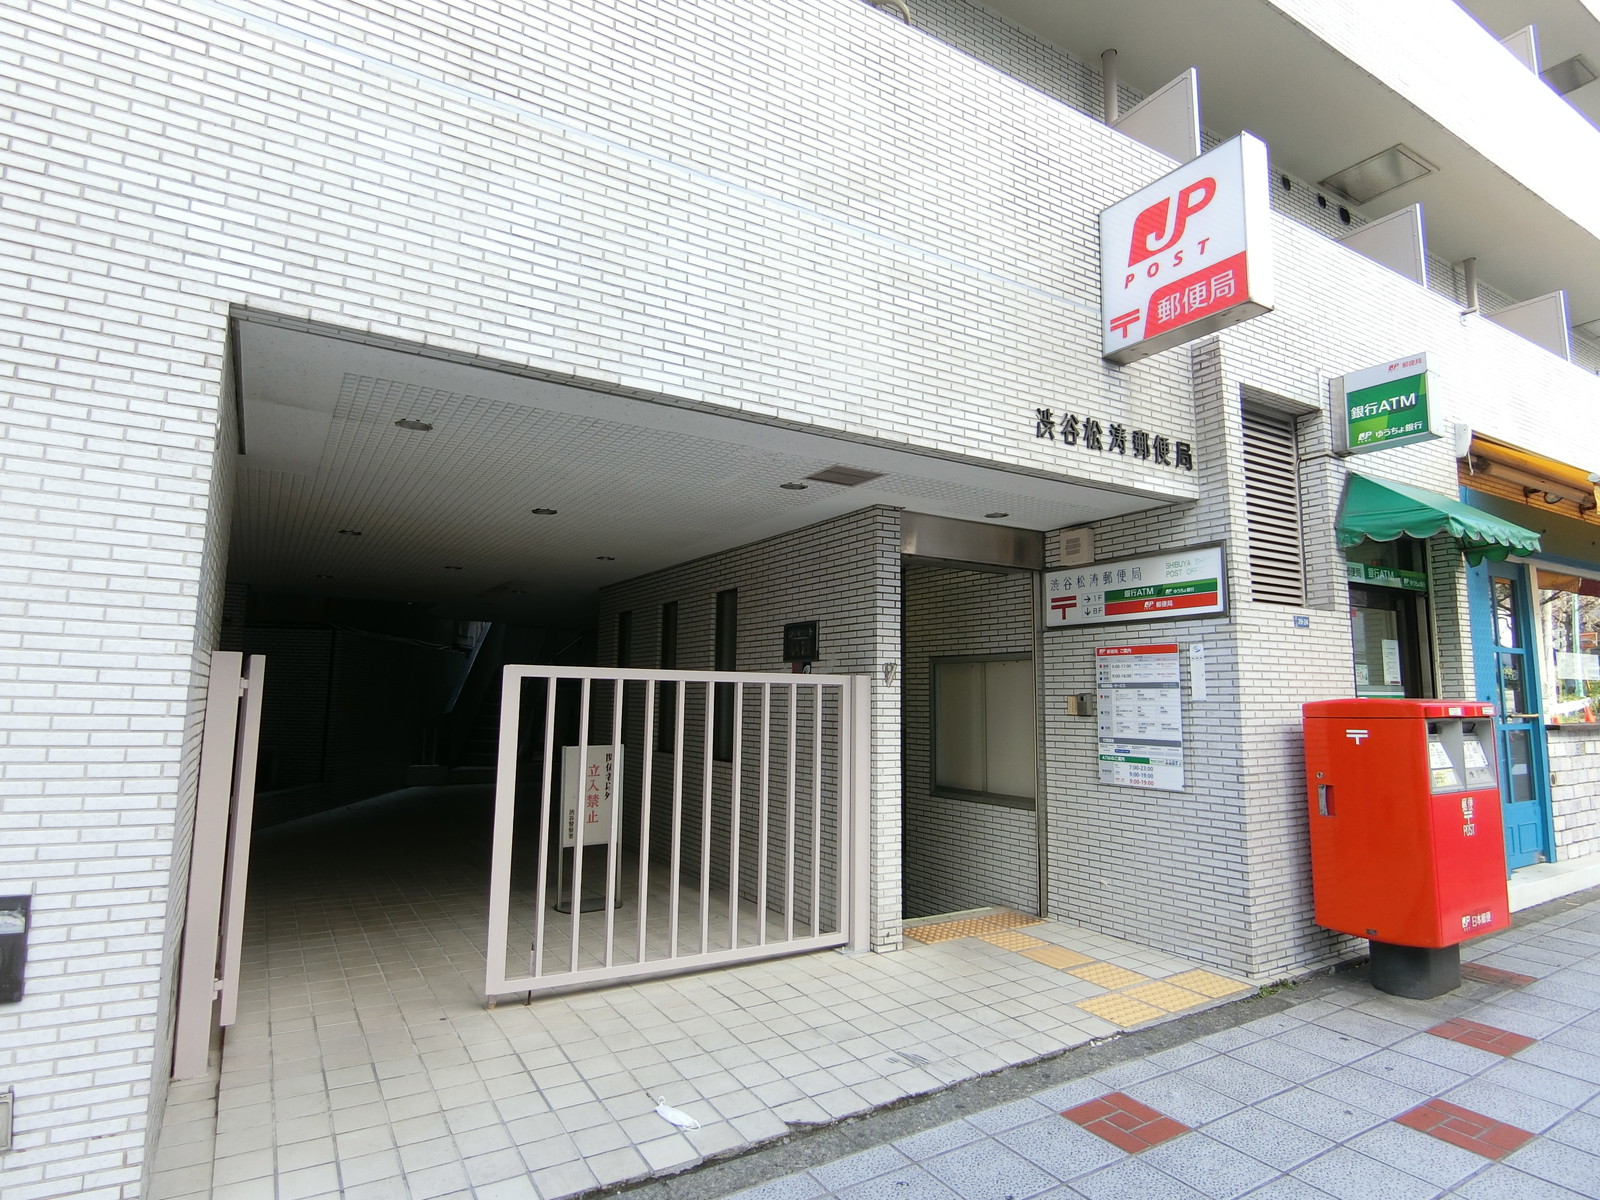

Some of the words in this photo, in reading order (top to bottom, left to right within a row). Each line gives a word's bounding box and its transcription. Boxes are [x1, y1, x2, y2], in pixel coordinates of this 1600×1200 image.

[1128, 177, 1216, 267] JP
[1124, 238, 1210, 289] POST
[1157, 269, 1236, 324] 郵便局
[1351, 392, 1416, 419] 銀行ATM
[1036, 408, 1193, 471] 渋谷松涛郵便局
[1375, 421, 1423, 438] ゆうちょ銀行
[1165, 559, 1191, 570] SHIBUYA
[1165, 569, 1182, 577] POST
[1050, 566, 1142, 591] 渋谷松涛郵便局
[1124, 587, 1154, 598] 銀行ATM
[587, 764, 600, 823] 立入禁止
[1461, 797, 1474, 811] 郵便
[1463, 824, 1476, 837] POST
[1472, 911, 1492, 927] 日本郵便
